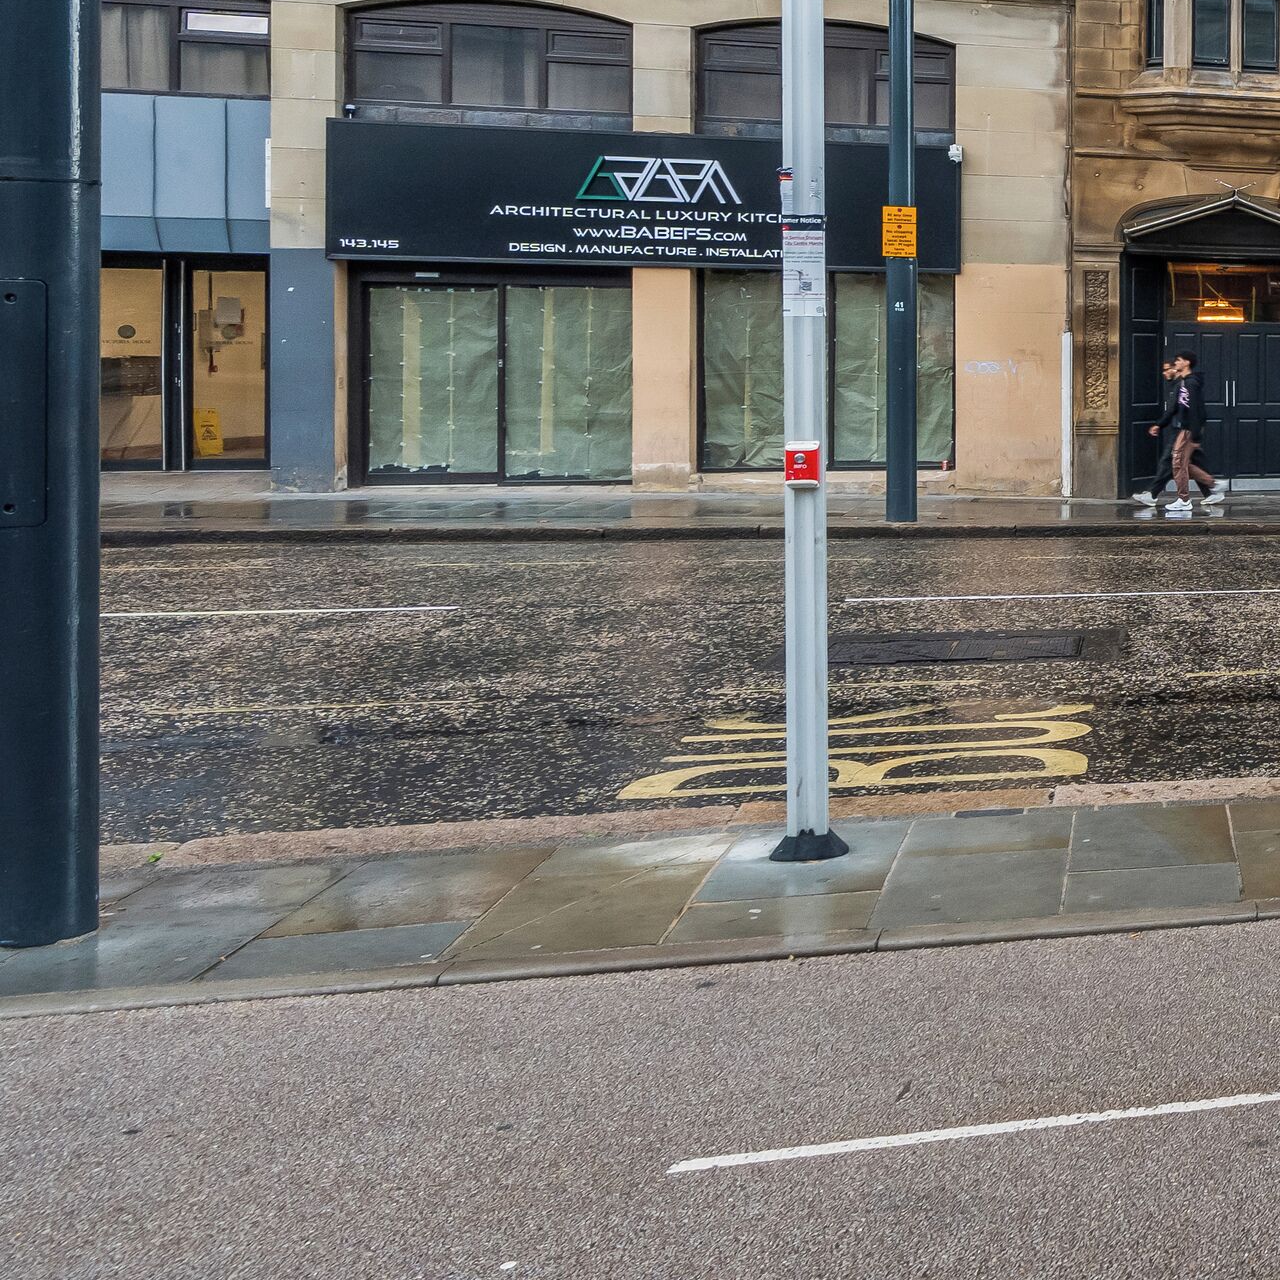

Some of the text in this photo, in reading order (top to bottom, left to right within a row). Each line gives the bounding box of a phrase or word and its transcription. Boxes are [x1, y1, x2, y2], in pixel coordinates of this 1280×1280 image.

[489, 204, 651, 220] ARCHITECTURAL
[655, 209, 732, 222] LUXURY
[508, 242, 566, 253] DESIGN
[575, 244, 697, 256] MANUFACTURE
